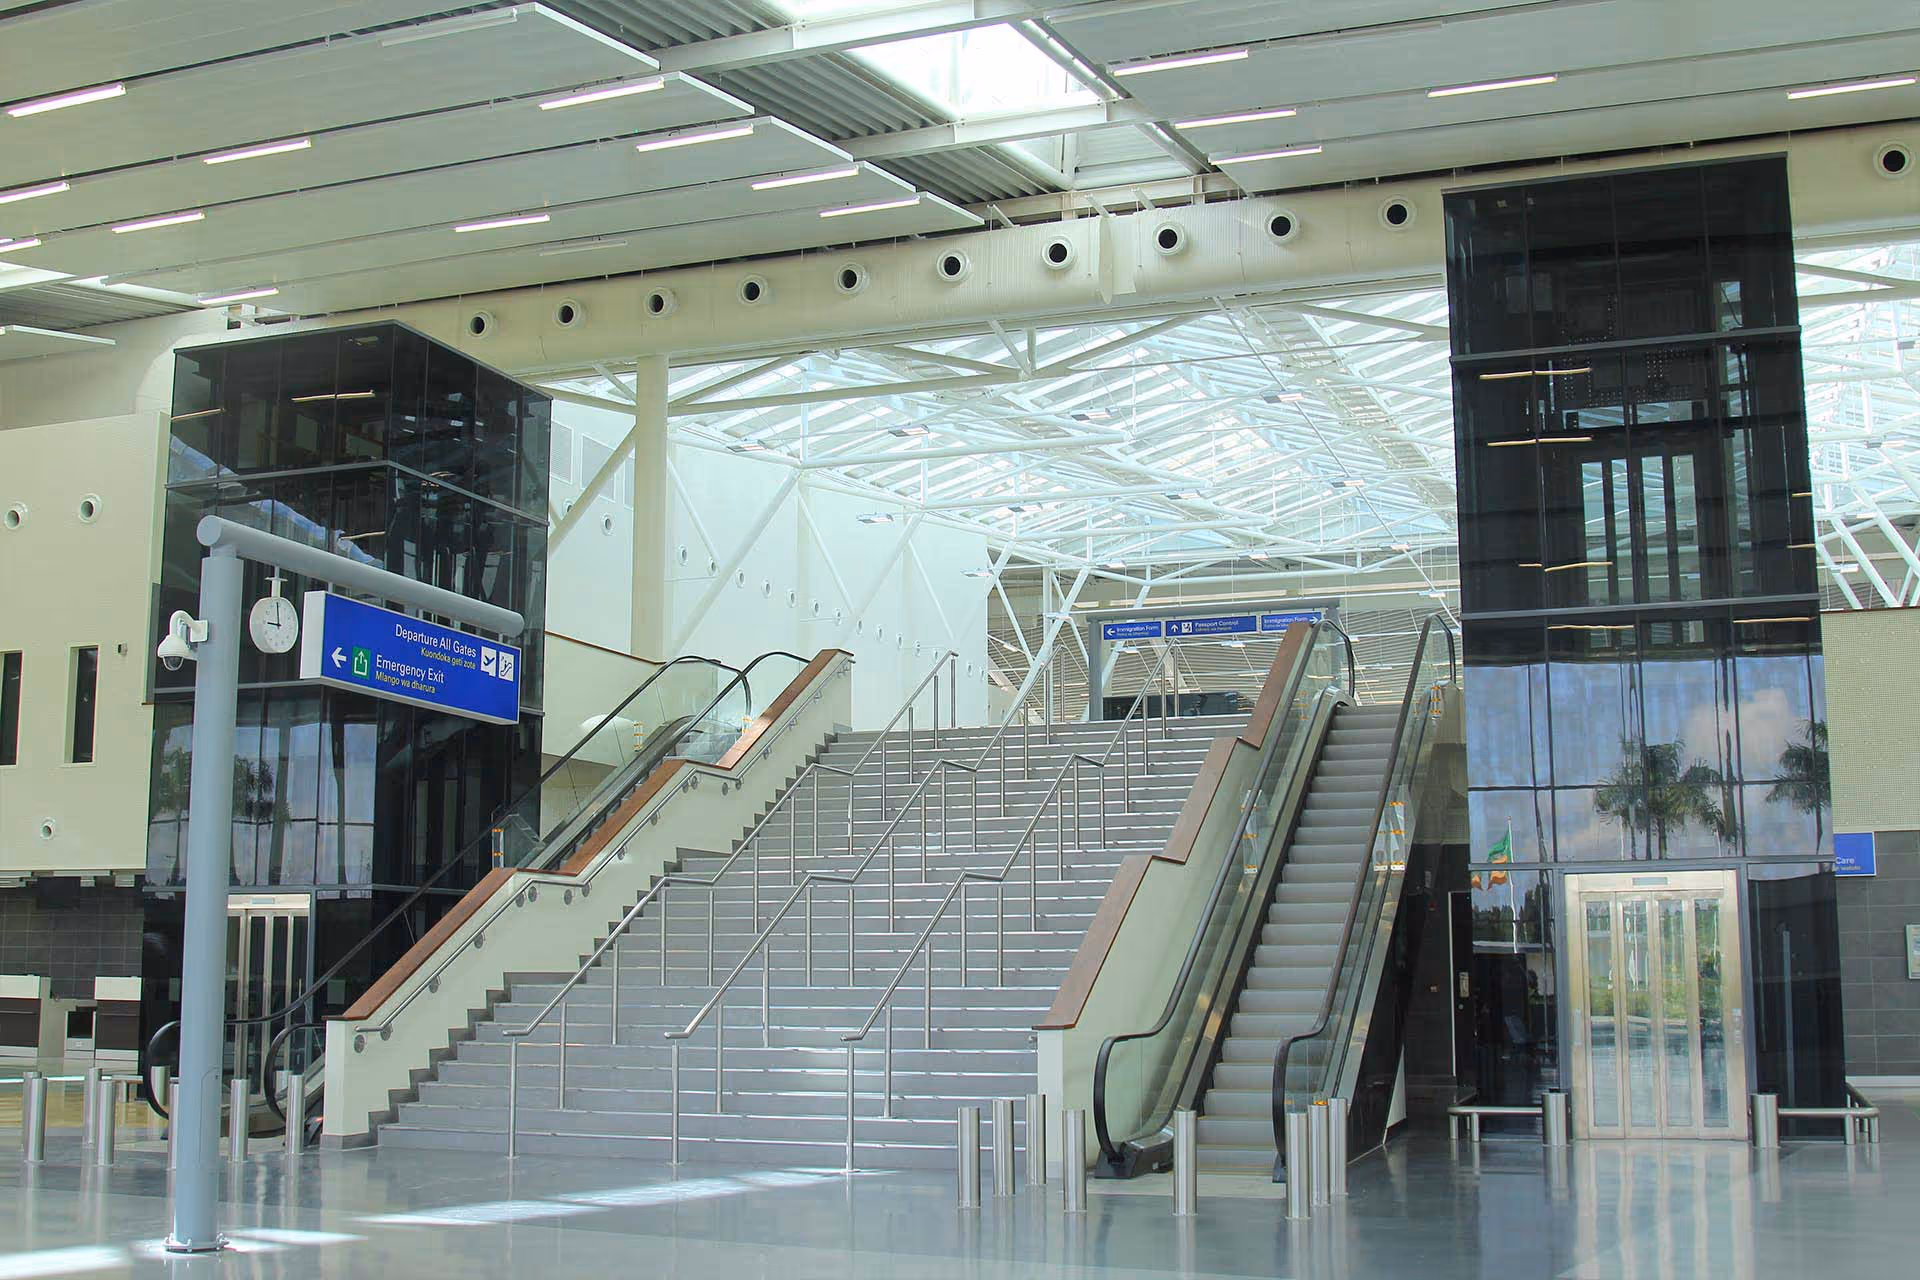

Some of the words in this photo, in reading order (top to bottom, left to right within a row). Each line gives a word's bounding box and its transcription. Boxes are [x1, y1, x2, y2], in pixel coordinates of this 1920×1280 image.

[395, 623, 438, 647] Departure
[439, 637, 451, 651] All
[453, 640, 477, 658] Gates
[421, 647, 451, 662] Kuondoka
[376, 654, 426, 682] Emergency
[428, 667, 444, 684] Exit
[375, 670, 400, 686] Mlango
[401, 678, 410, 688] wa
[411, 680, 436, 694] dharura
[1835, 856, 1855, 864] Care
